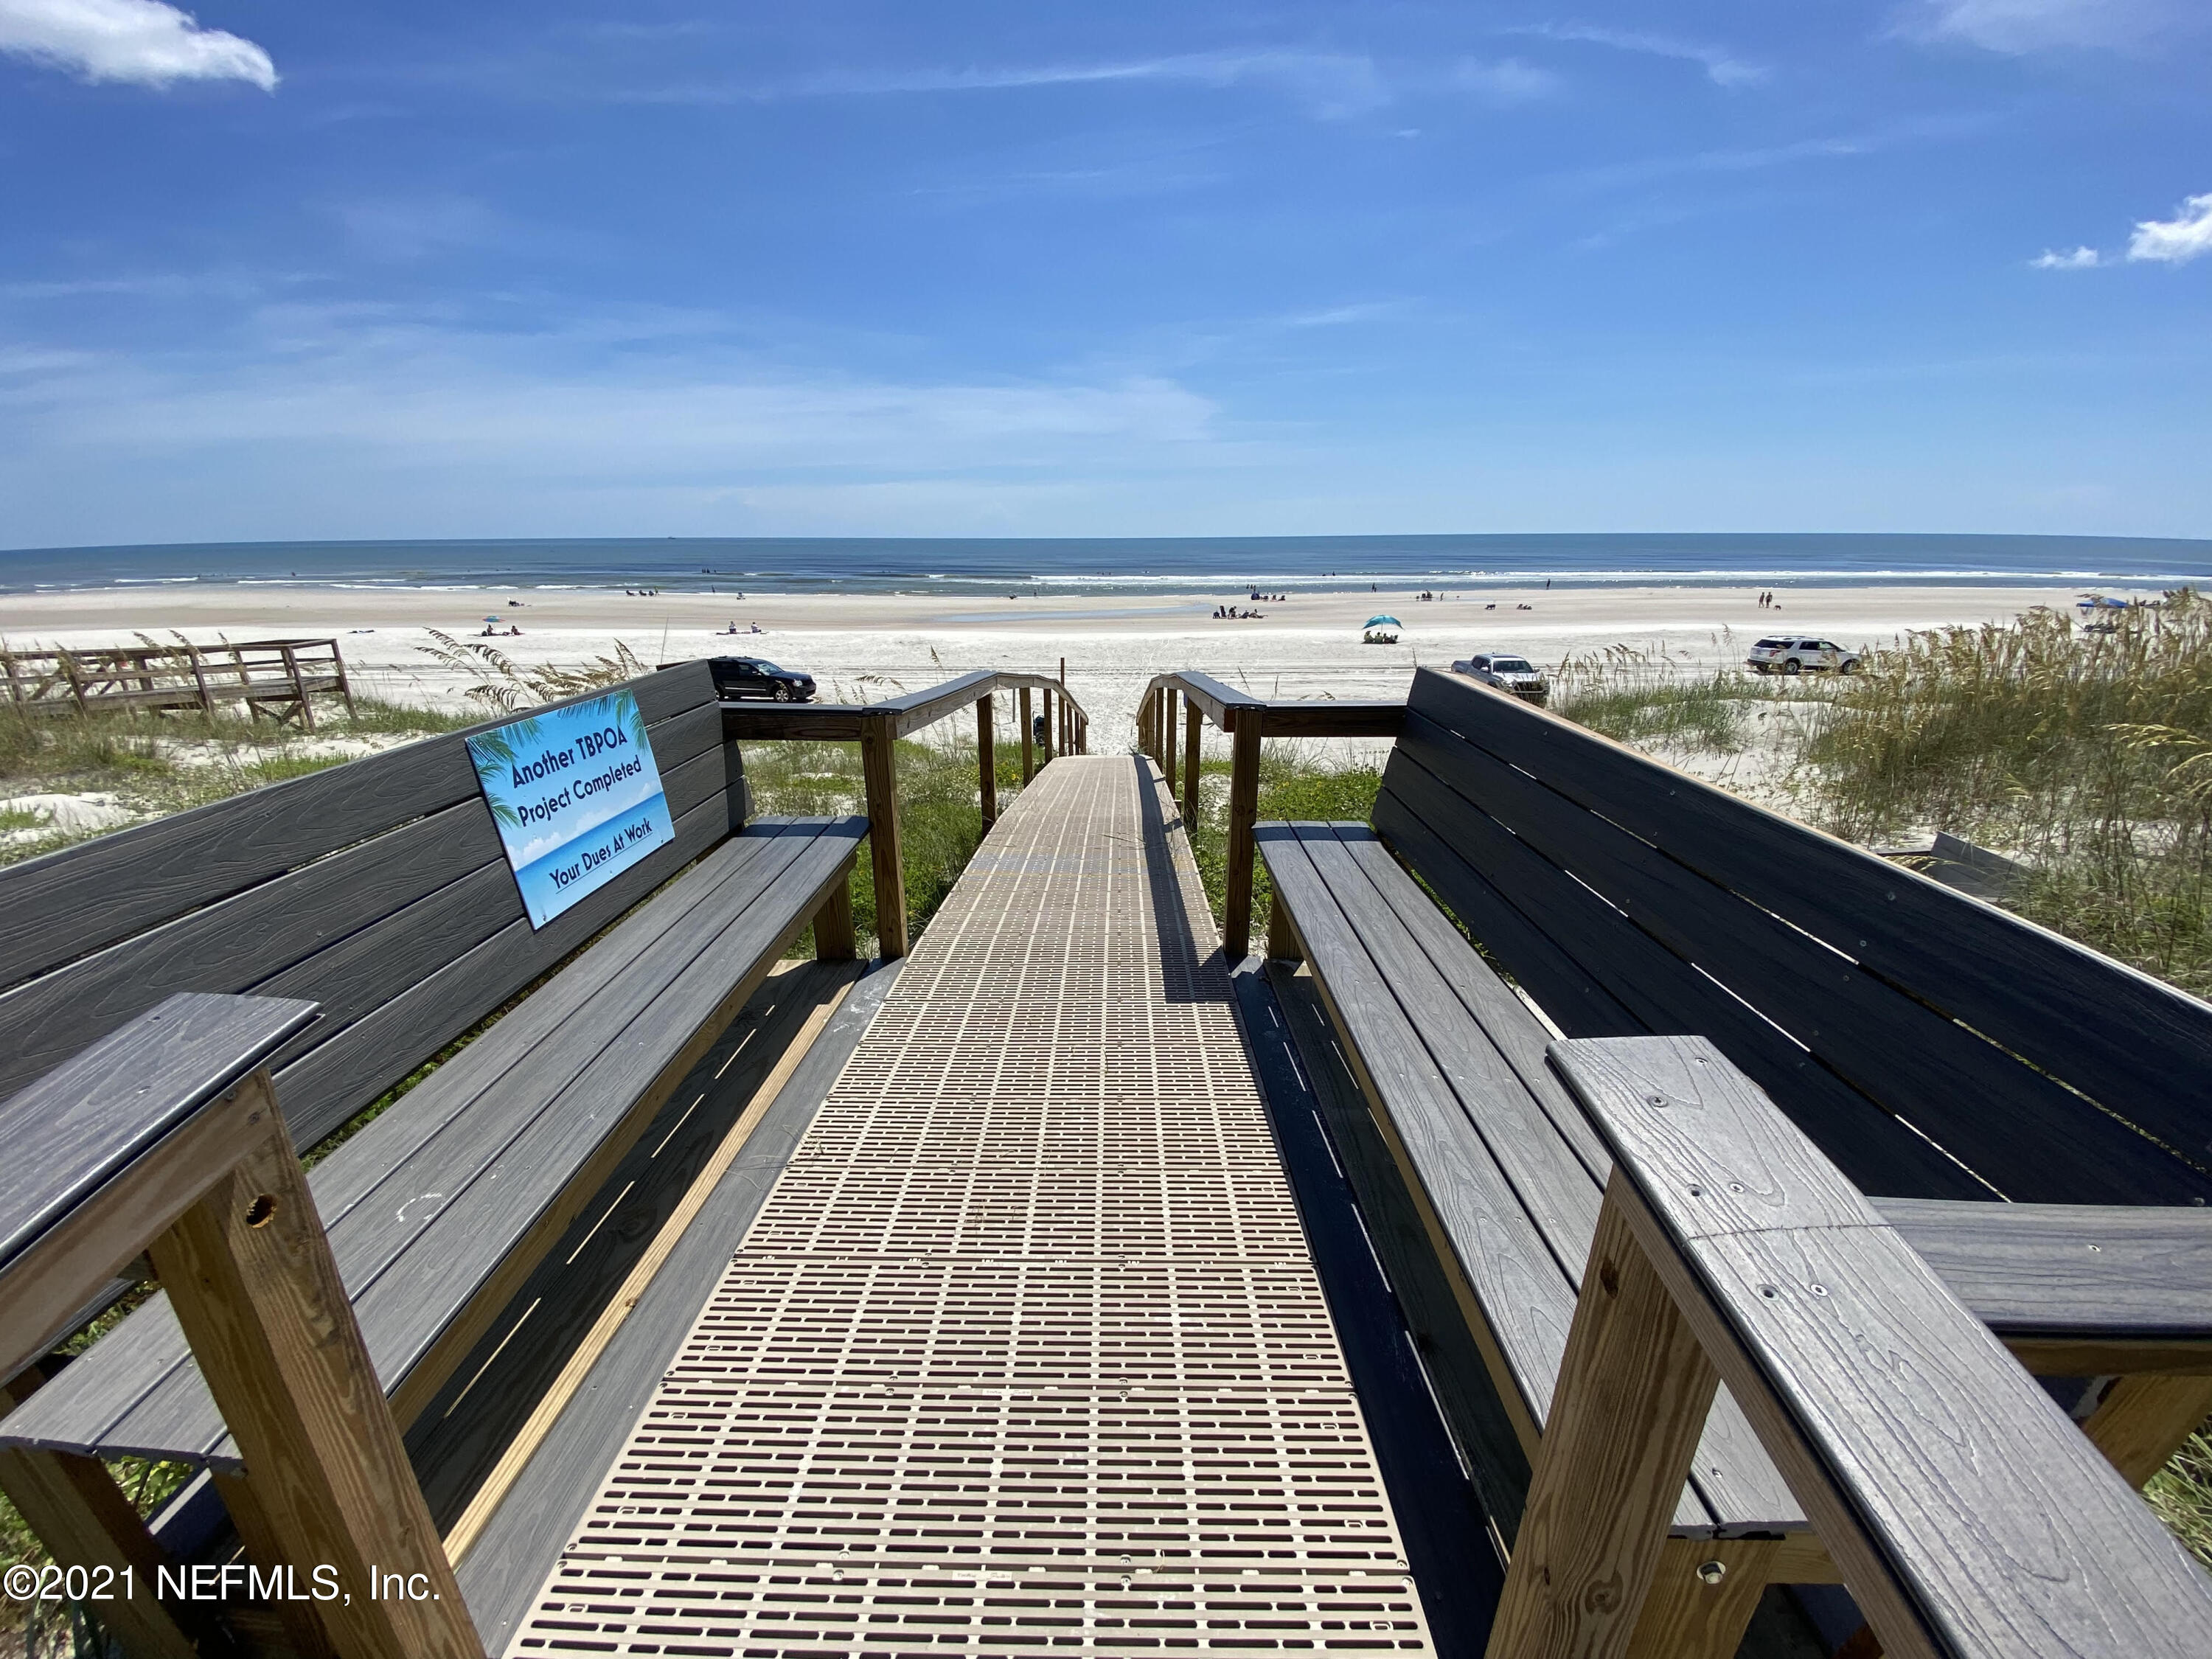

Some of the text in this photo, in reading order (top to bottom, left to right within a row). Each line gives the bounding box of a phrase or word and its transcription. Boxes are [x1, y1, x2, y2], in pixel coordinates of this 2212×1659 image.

[512, 726, 627, 789] Another TBPOA
[517, 755, 642, 827] Project Completed
[549, 817, 653, 889] Your Dues At Work
